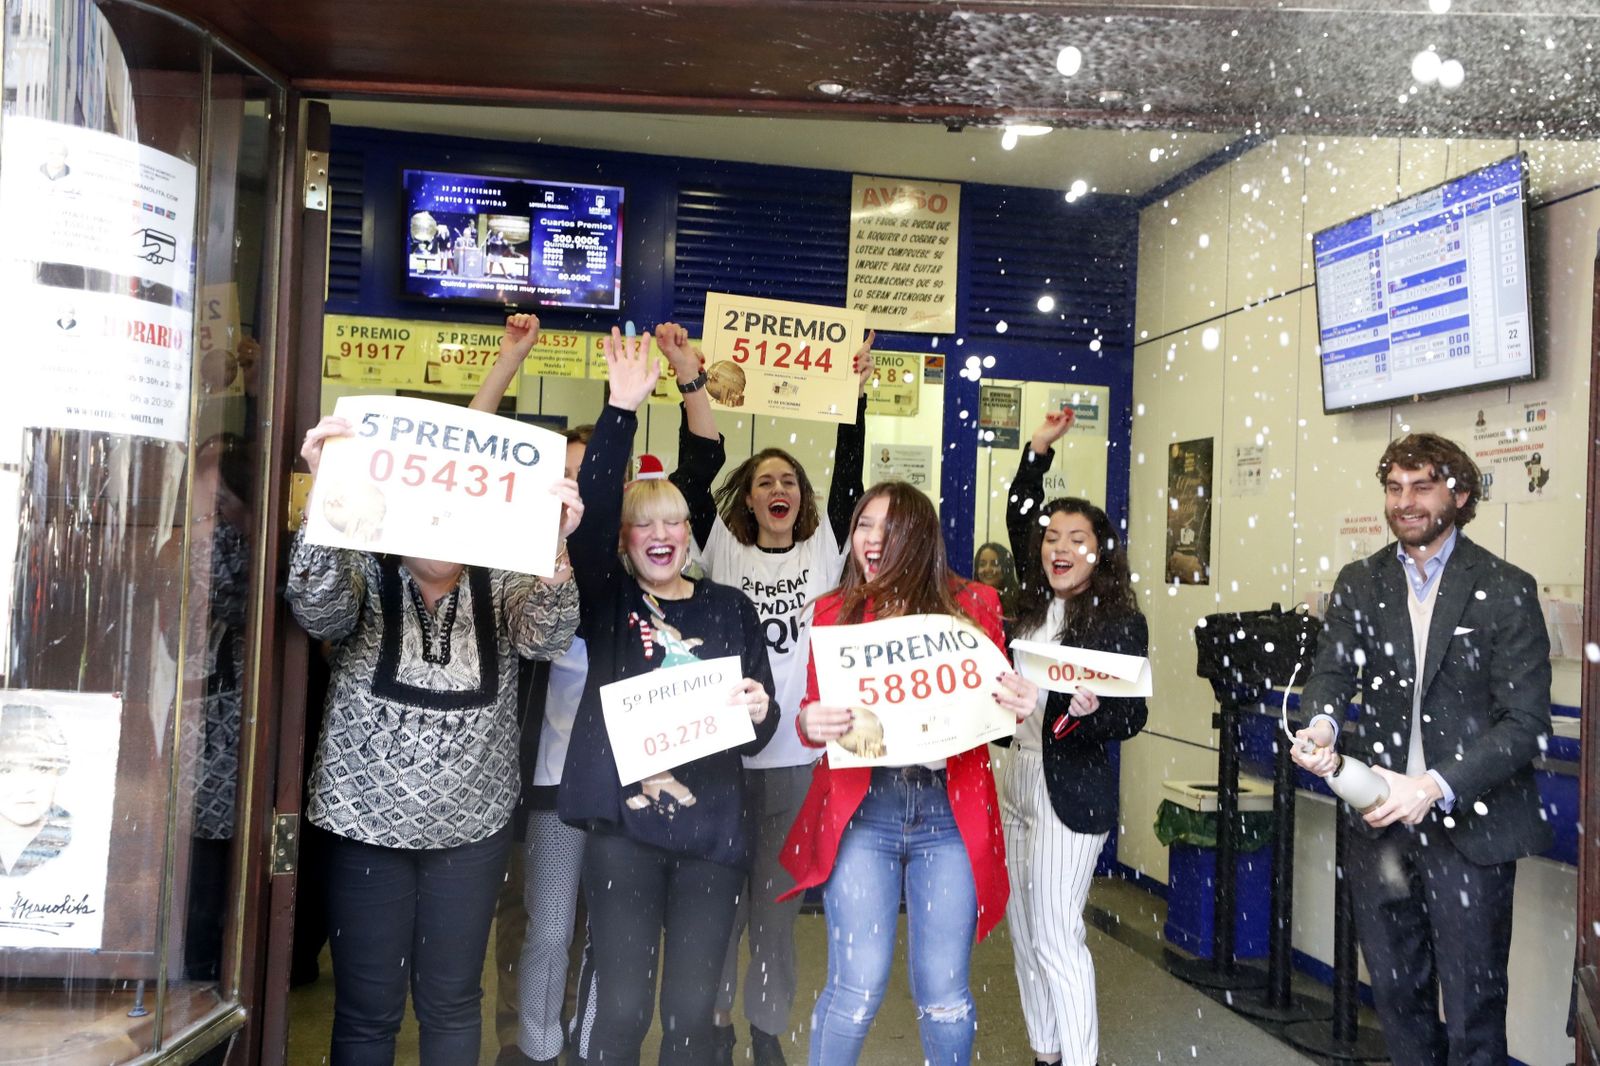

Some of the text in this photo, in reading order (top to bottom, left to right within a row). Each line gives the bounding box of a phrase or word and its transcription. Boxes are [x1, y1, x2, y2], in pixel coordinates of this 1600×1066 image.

[540, 218, 614, 231] Cuartos Premios
[574, 243, 608, 252] Premios
[856, 260, 889, 272] IMPORTE
[891, 262, 911, 272] PARA
[854, 274, 915, 288] RECLAMACIONES
[870, 304, 908, 316] MOMENTO
[350, 326, 411, 341] PREMIO
[745, 312, 847, 344] PREMIO
[1508, 328, 1520, 340] 22
[536, 334, 578, 348] 4.537
[340, 342, 406, 361] 91917
[732, 338, 833, 374] 51244
[390, 415, 540, 466] PREMIO
[369, 448, 517, 503] 05431
[864, 629, 979, 668] PREMIO
[858, 658, 983, 706] 58808
[622, 671, 723, 713] 5º PREMIO
[643, 715, 718, 757] 03.278
